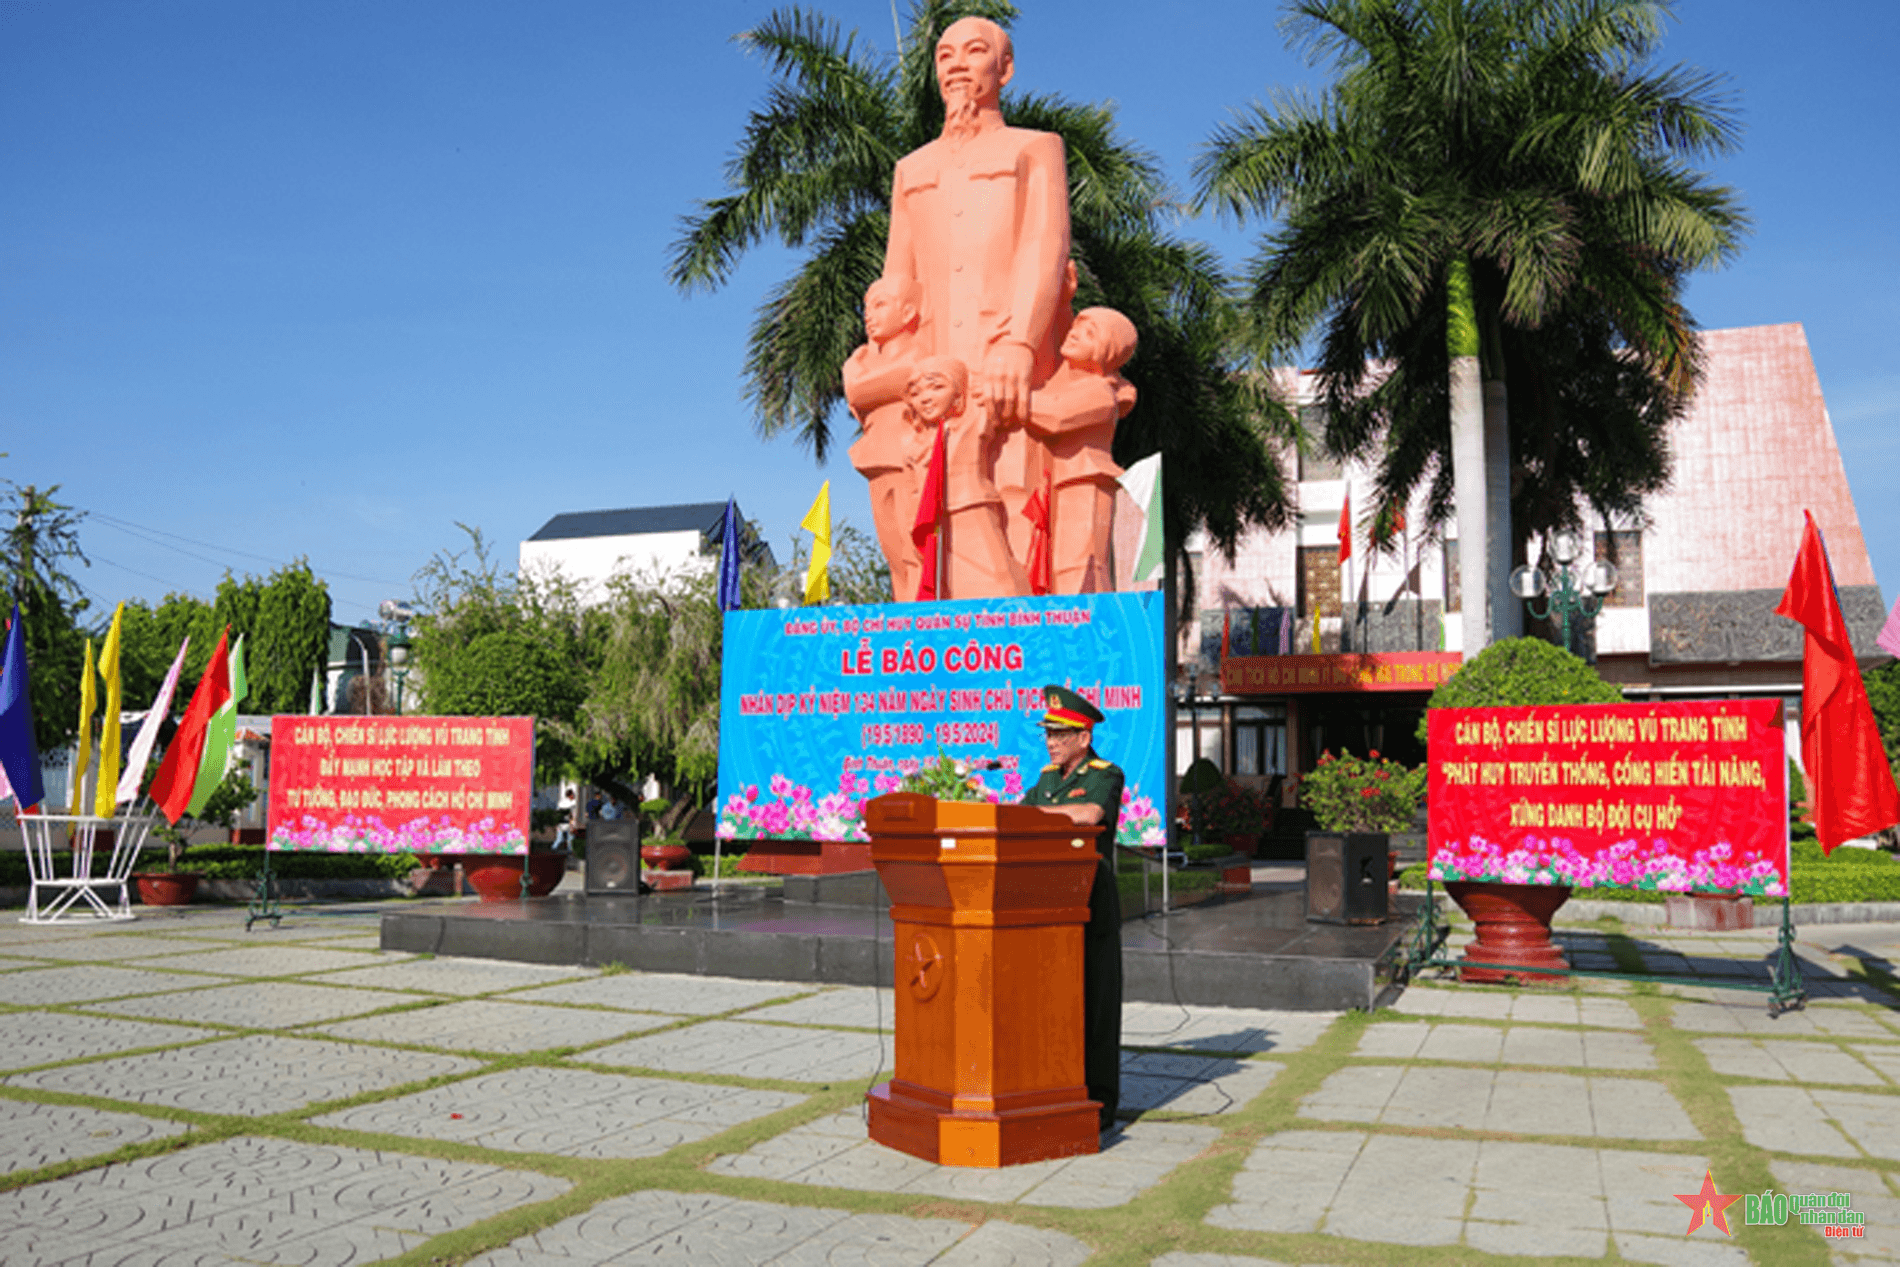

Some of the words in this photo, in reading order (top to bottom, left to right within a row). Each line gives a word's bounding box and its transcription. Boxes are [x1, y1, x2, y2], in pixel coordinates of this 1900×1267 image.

[886, 617, 913, 632] HUY
[1044, 606, 1091, 629] THUẬN
[841, 637, 874, 676] LỄ
[881, 639, 937, 675] BÁO
[943, 638, 1024, 674] CÔNG
[739, 688, 774, 715] NHÂN
[776, 693, 797, 721] DỊP
[818, 687, 850, 720] NIỆM
[854, 691, 875, 714] 134
[878, 685, 907, 714] NĂM
[910, 683, 947, 713] NGÀY
[949, 688, 982, 712] SINH
[984, 679, 1014, 712] CHỦ
[1104, 686, 1142, 710] MINH
[294, 722, 315, 746] CÁN
[334, 719, 364, 746] CHIẾN
[379, 724, 398, 750] LỰC
[400, 724, 432, 751] LƯỢNG
[435, 721, 448, 746] VŨ
[450, 726, 483, 746] TRANG
[485, 720, 510, 746] TỈNH
[1455, 715, 1481, 745] CÁN
[1483, 715, 1503, 751] BỘ,
[1505, 710, 1545, 744] CHIẾN
[1547, 712, 1560, 744] SĨ
[1562, 714, 1588, 751] LỰC
[1590, 713, 1636, 750] LƯỢNG
[1638, 709, 1658, 743] VŨ
[1660, 715, 1709, 743] TRANG
[1711, 706, 1748, 742] TỈNH
[342, 758, 370, 782] MẠNH
[372, 758, 393, 782] HỌC
[395, 754, 415, 782] TẬP
[416, 754, 429, 777] VÀ
[431, 754, 452, 777] LÀM
[454, 758, 481, 777] THEO
[1480, 761, 1506, 786] HUY
[1509, 751, 1559, 786] TRUYỀN
[1561, 750, 1611, 791] THỐNG,
[1612, 750, 1652, 786] CỐNG
[1654, 750, 1690, 786] HIẾN
[1691, 753, 1716, 787] TÀI
[1719, 754, 1767, 793] NĂNG,
[387, 790, 420, 808] PHONG
[422, 785, 449, 809] CÁCH
[451, 782, 466, 809] HỒ
[467, 785, 484, 809] CHÍ
[486, 790, 513, 809] MINH
[1509, 796, 1544, 827] XỨNG
[1548, 803, 1584, 827] DANH
[1586, 798, 1605, 836] BỘ
[1607, 798, 1632, 836] ĐỘI
[1633, 803, 1654, 837] CỤ
